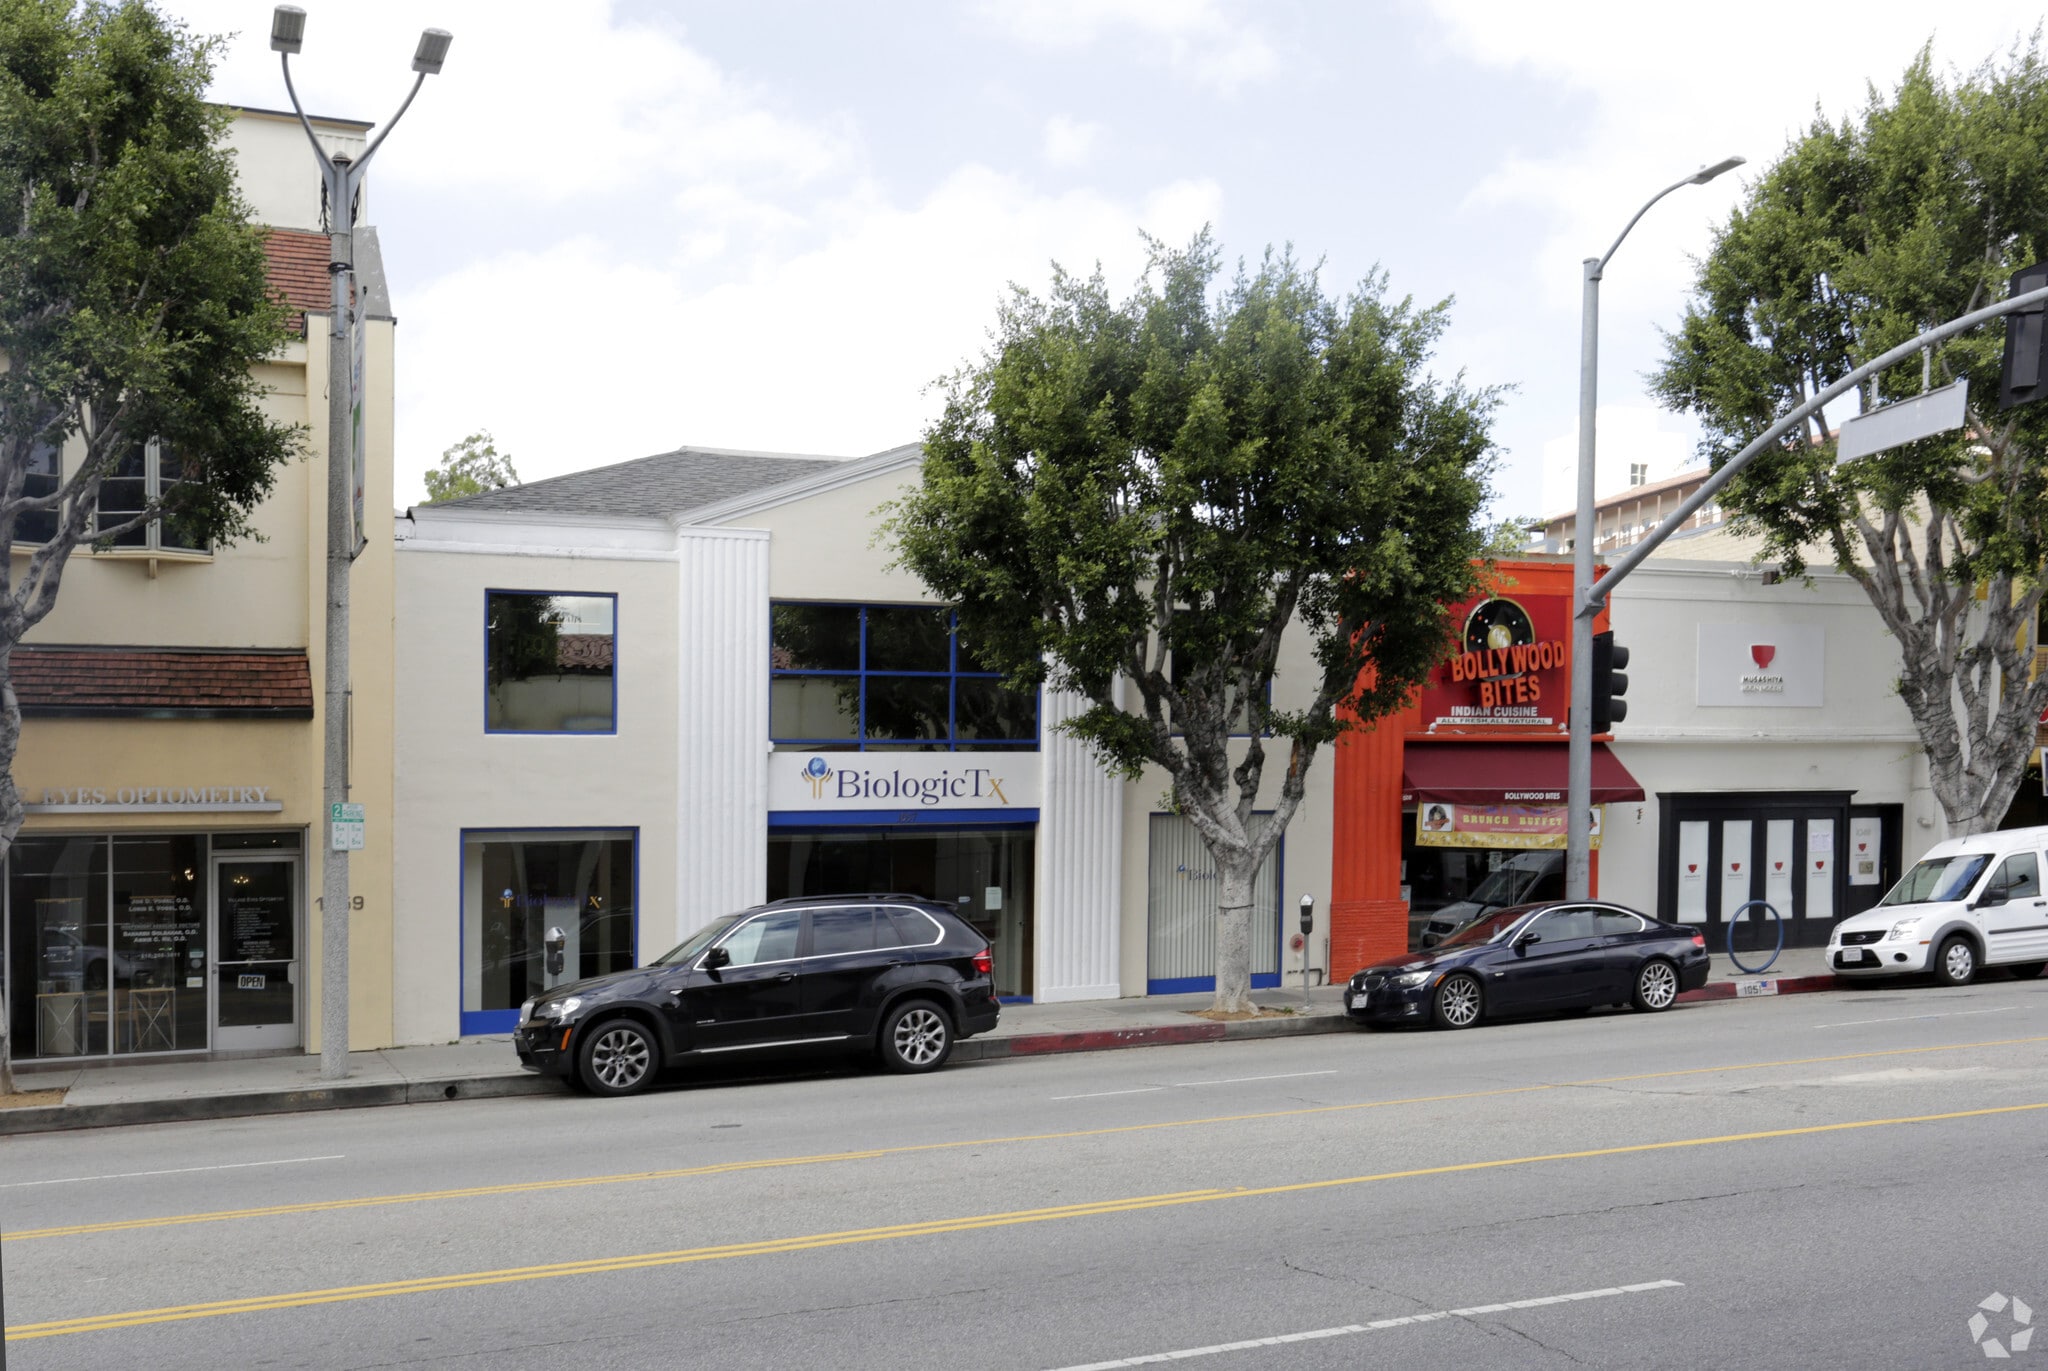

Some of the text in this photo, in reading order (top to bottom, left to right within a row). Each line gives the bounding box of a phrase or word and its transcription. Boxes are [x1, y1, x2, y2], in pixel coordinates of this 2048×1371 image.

[1451, 640, 1565, 682] BOLLYWOOD
[1480, 675, 1541, 708] BITES
[1451, 706, 1538, 717] INDIAN CUISINE
[837, 769, 1009, 805] BiologicTx
[41, 787, 106, 805] EYES
[116, 786, 270, 805] OPTOMETRY
[1504, 792, 1545, 800] BOLLYWOOD
[334, 805, 341, 817] 2
[1463, 814, 1562, 826] BRUNCH BUFFET
[240, 976, 264, 988] OPEN
